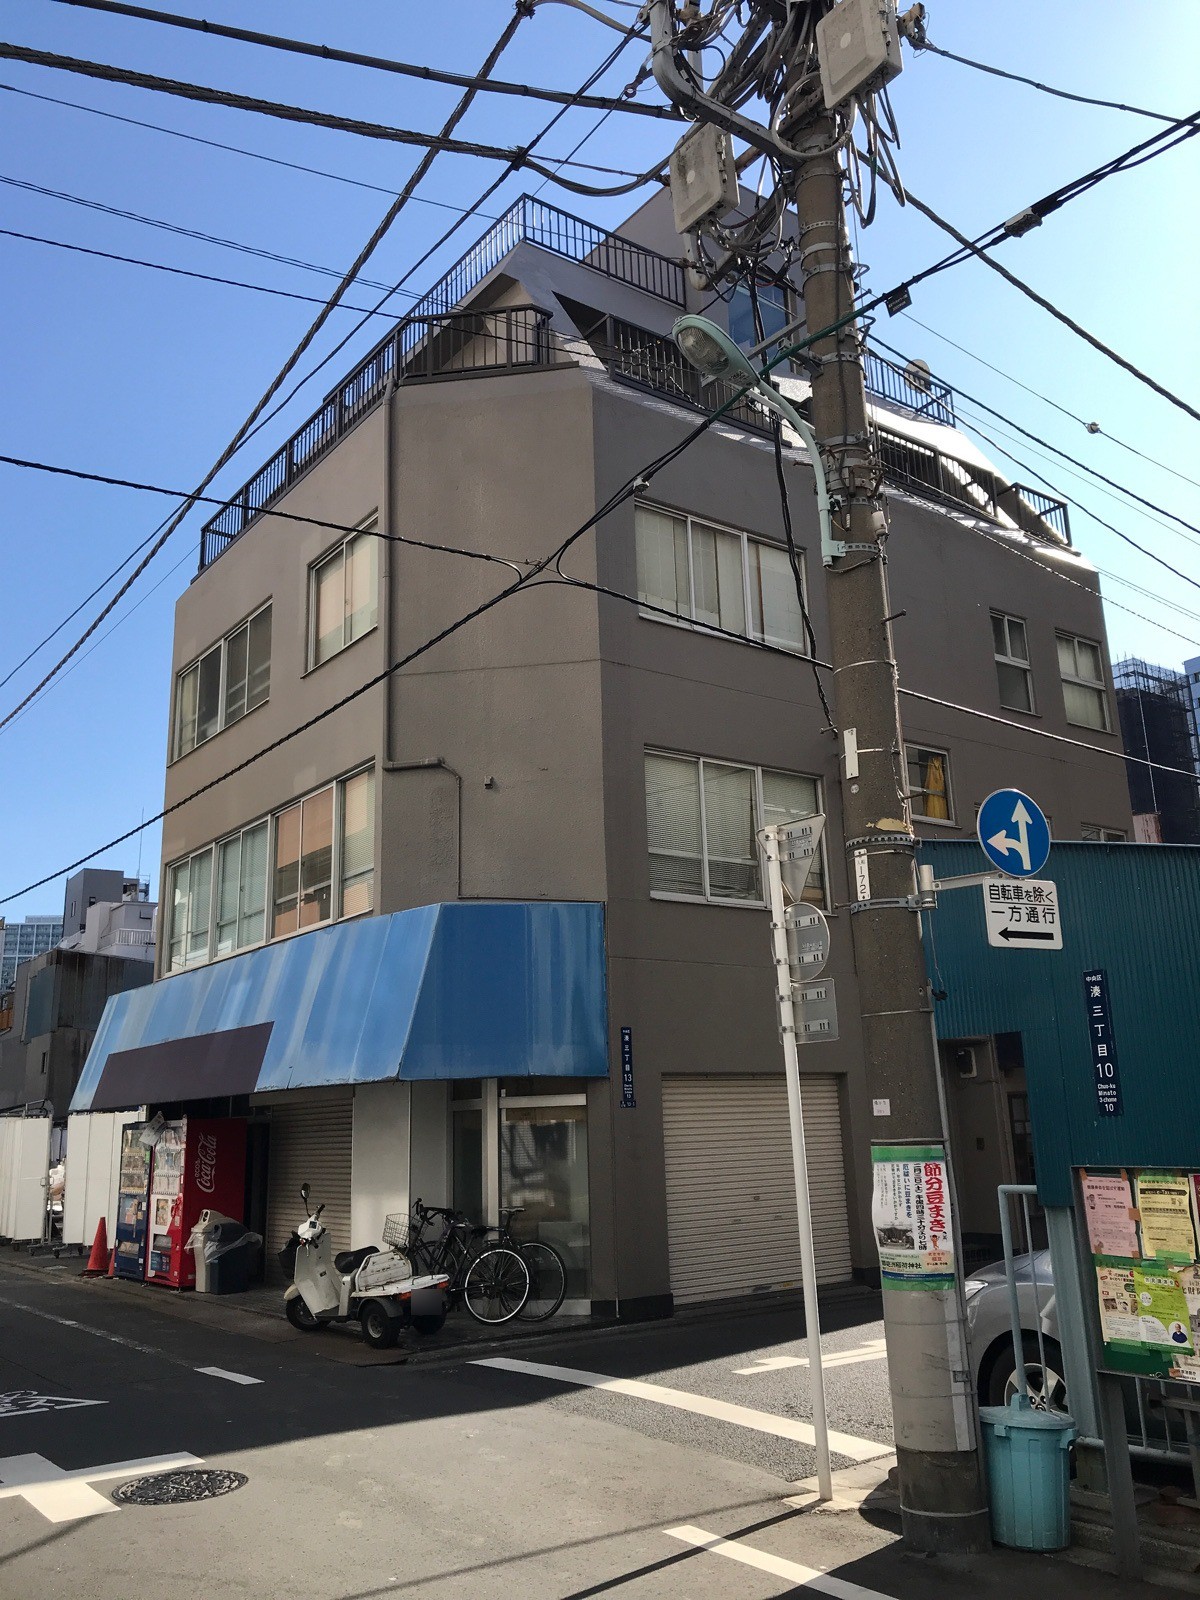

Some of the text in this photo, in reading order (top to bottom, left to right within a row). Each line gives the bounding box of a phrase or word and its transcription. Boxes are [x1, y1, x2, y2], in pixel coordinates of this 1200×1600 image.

[858, 866, 867, 894] 172
[988, 883, 1054, 904] 自転車を除く
[991, 905, 1056, 924] 一方通行
[1085, 974, 1103, 982] 中央区
[1105, 1103, 1114, 1112] 10
[196, 1131, 217, 1193] Coca-Cola
[923, 1162, 946, 1233] 節分豆まき
